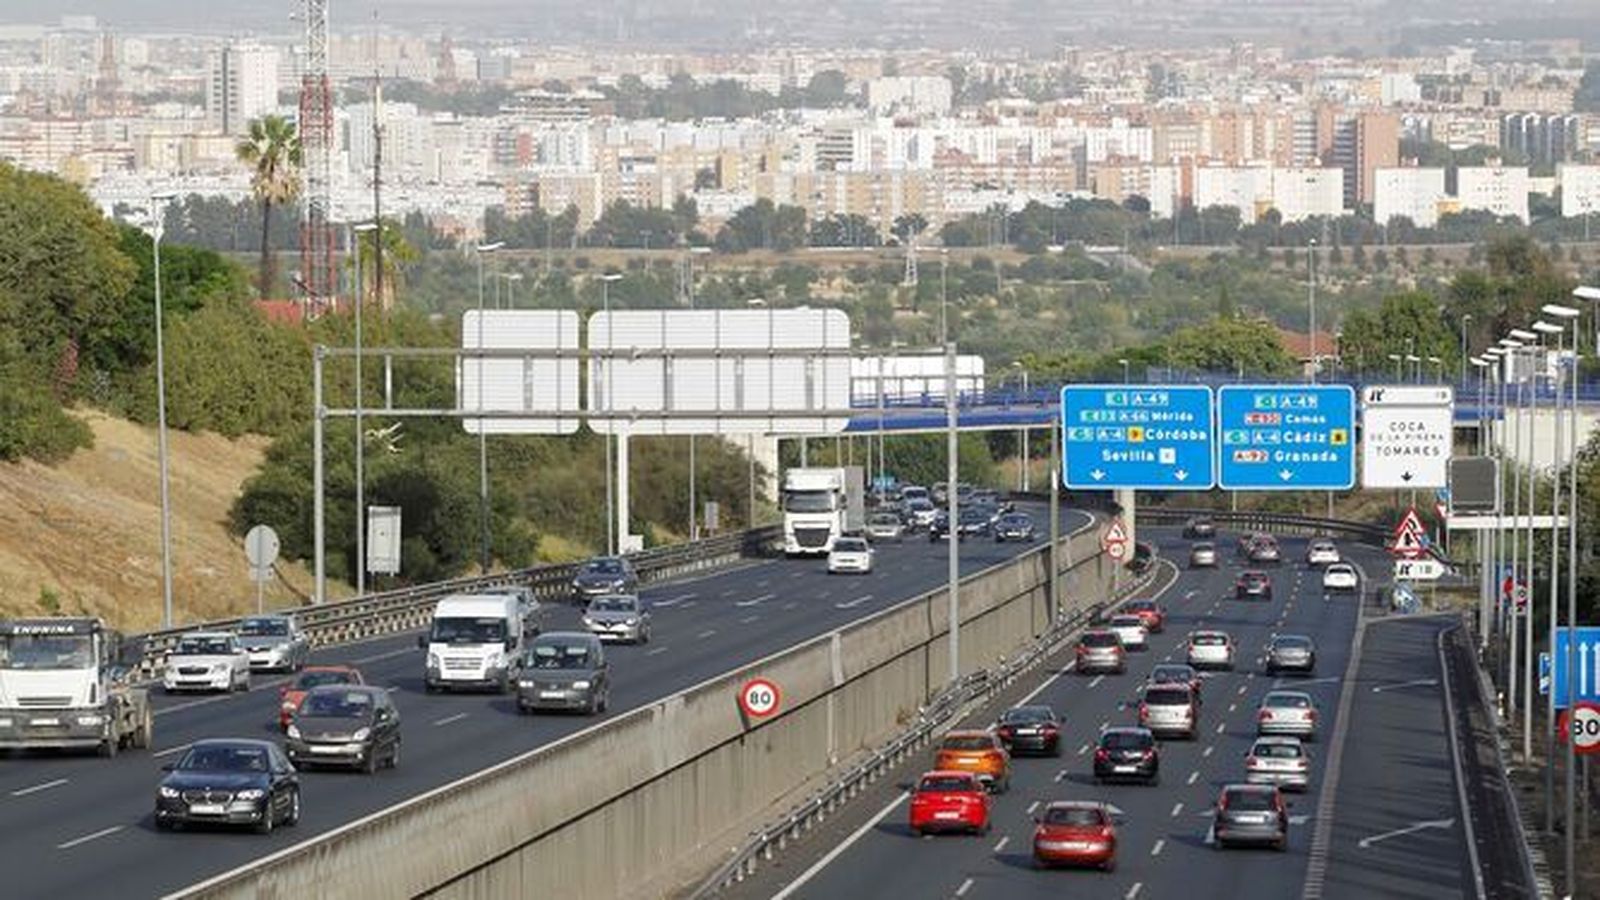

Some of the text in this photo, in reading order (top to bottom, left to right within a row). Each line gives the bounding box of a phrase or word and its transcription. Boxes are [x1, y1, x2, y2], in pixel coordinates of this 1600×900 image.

[1132, 392, 1168, 405] A-49
[1281, 395, 1317, 408] A-49
[1152, 411, 1193, 421] Mérida
[1285, 414, 1326, 423] Camas
[1389, 421, 1425, 432] COCA
[1097, 427, 1124, 440] A-4
[1145, 428, 1207, 440] Córdoba
[1253, 430, 1280, 444] A-4
[1283, 431, 1327, 443] Cádiz
[1102, 449, 1155, 461] Sevilla
[1235, 450, 1338, 462] A-92 Granada
[1376, 446, 1440, 456] TOMARES
[750, 691, 771, 705] 80
